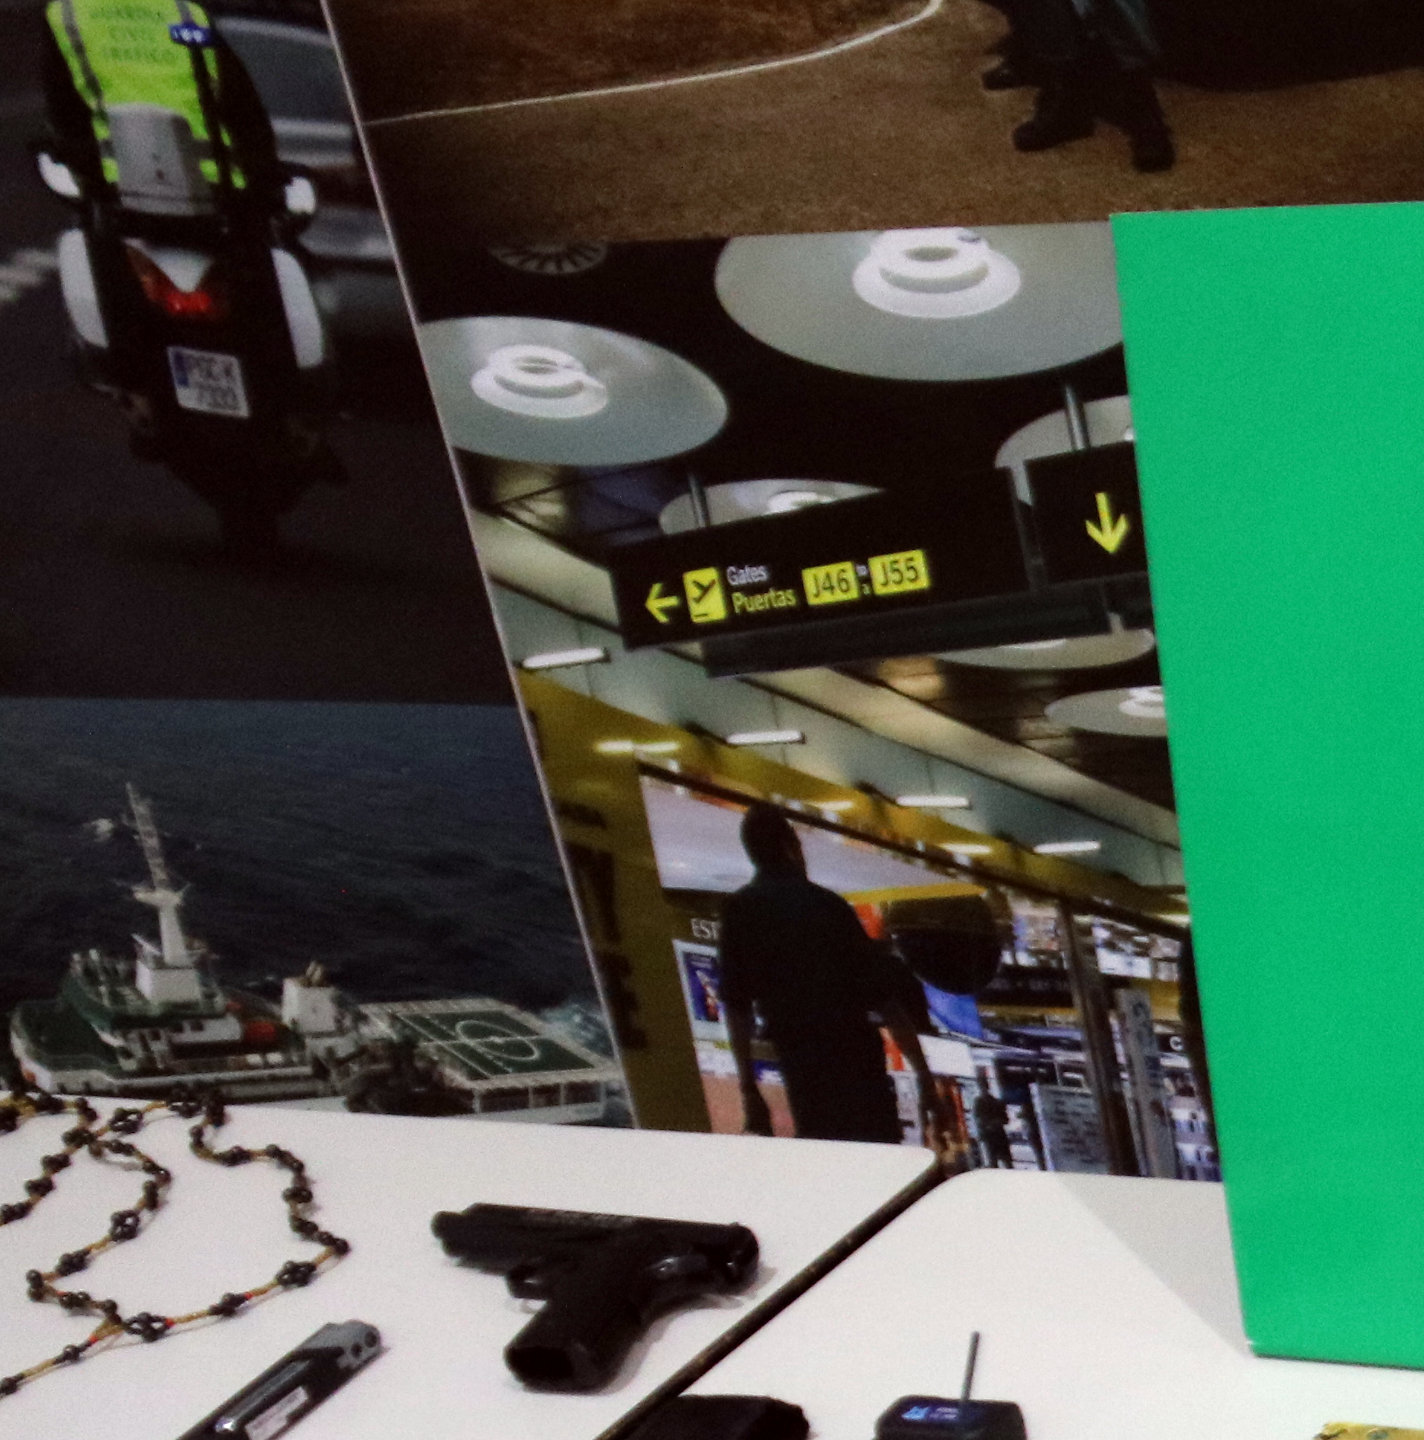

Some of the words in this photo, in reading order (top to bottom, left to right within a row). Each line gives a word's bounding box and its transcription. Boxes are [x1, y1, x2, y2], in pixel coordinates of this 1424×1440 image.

[727, 565, 768, 586] Gates
[812, 567, 851, 598] J46
[879, 556, 920, 587] J55
[732, 588, 796, 613] Puertas
